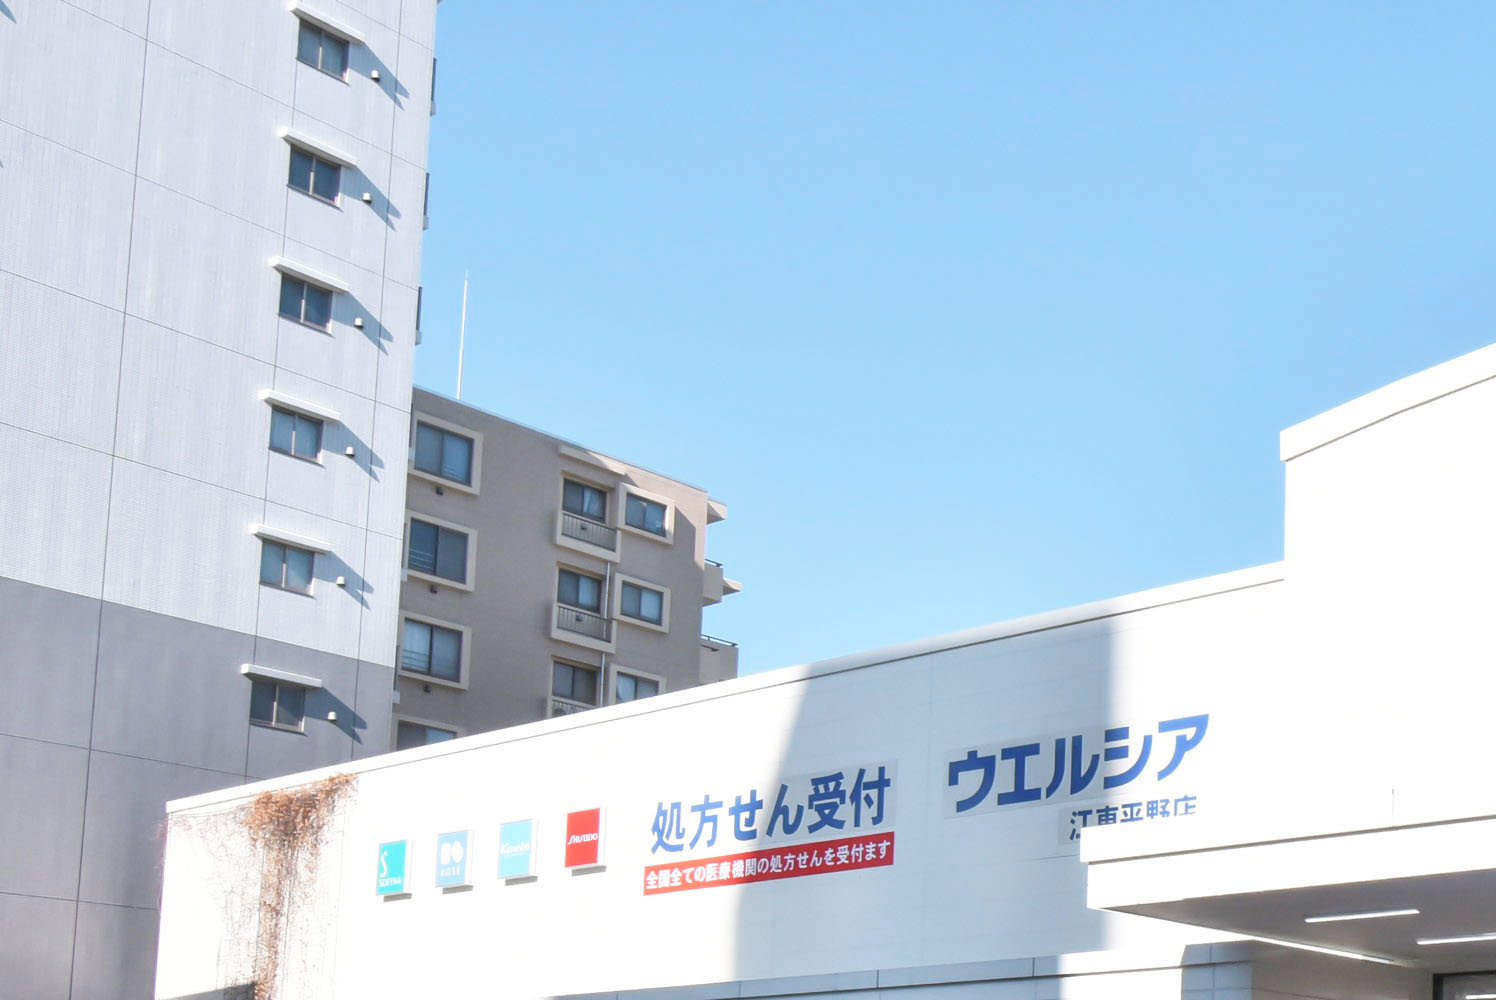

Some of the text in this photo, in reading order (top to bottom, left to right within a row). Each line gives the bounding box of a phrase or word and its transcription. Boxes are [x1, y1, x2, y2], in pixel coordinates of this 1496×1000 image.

[948, 713, 1209, 813] ウエルシア
[651, 766, 891, 855] 処方せん受付
[645, 839, 892, 890] 全国全ての医療機関の処方せんを受付ます
